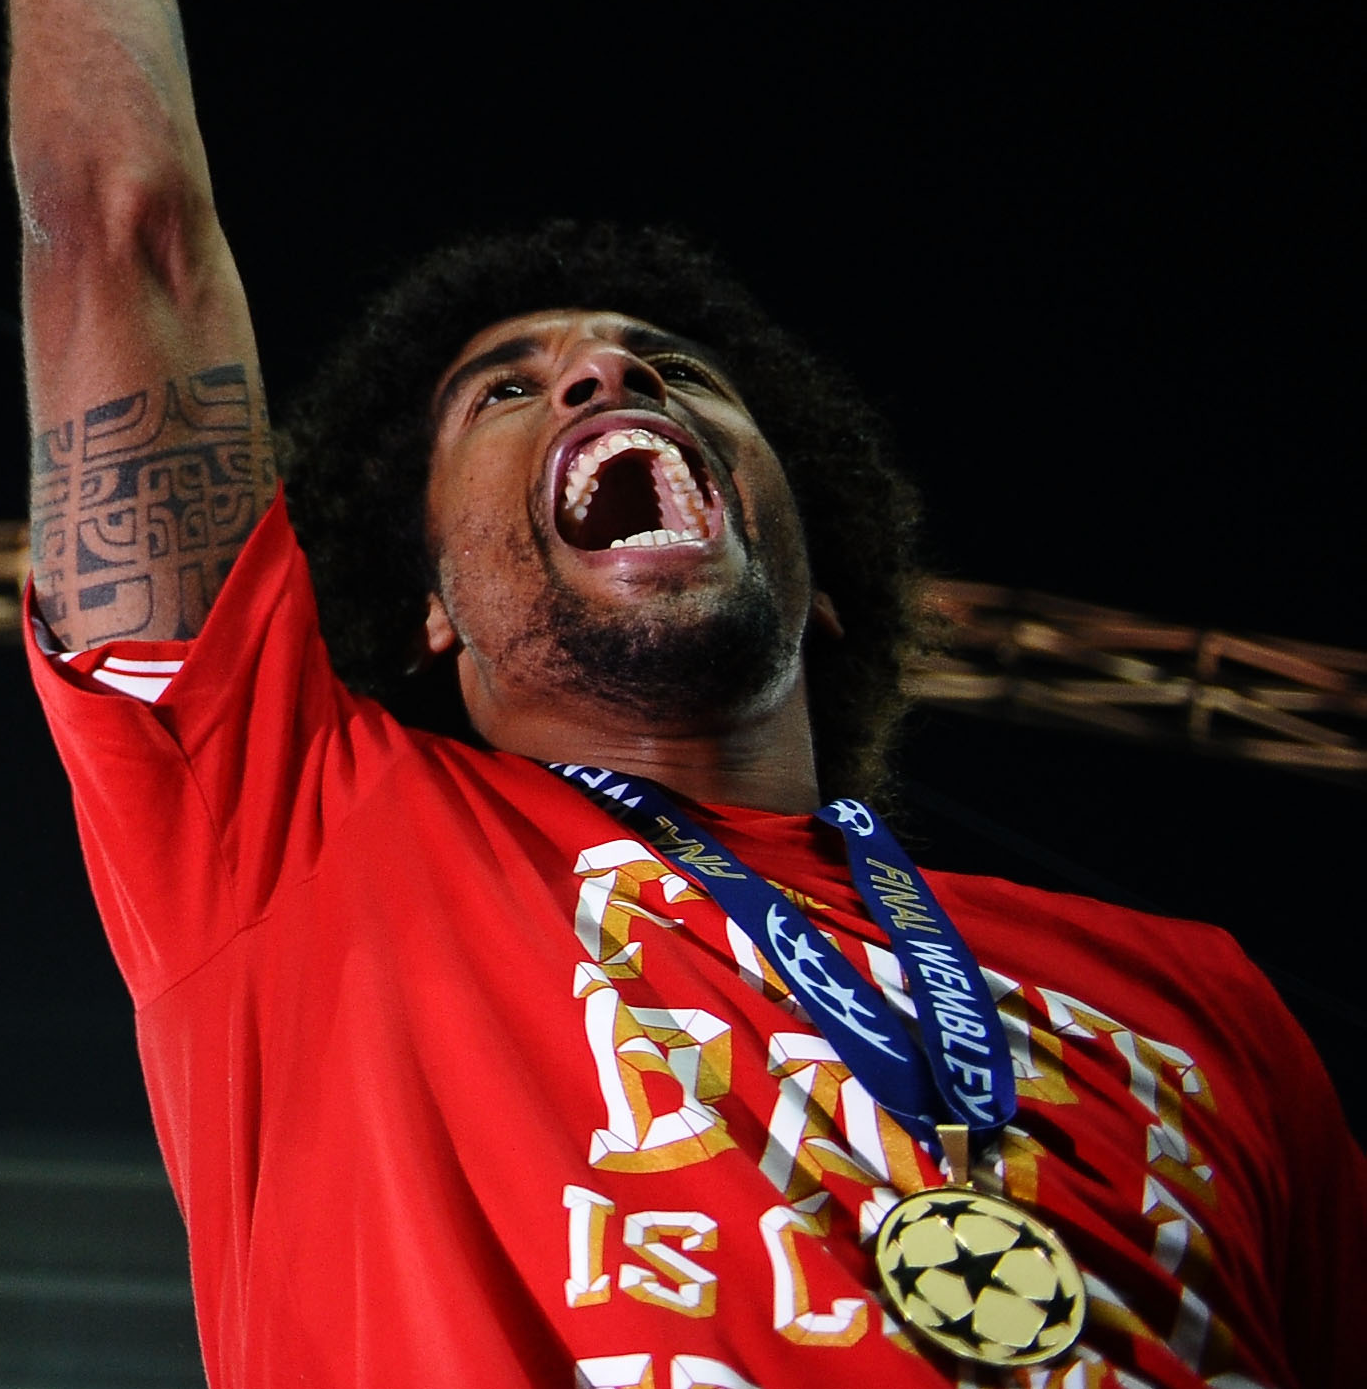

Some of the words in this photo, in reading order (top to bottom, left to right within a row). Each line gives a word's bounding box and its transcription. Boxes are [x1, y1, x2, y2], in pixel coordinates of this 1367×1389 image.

[865, 856, 943, 935] FINAL
[905, 939, 995, 1123] WEMBLEY
[562, 1184, 719, 1319] IS
